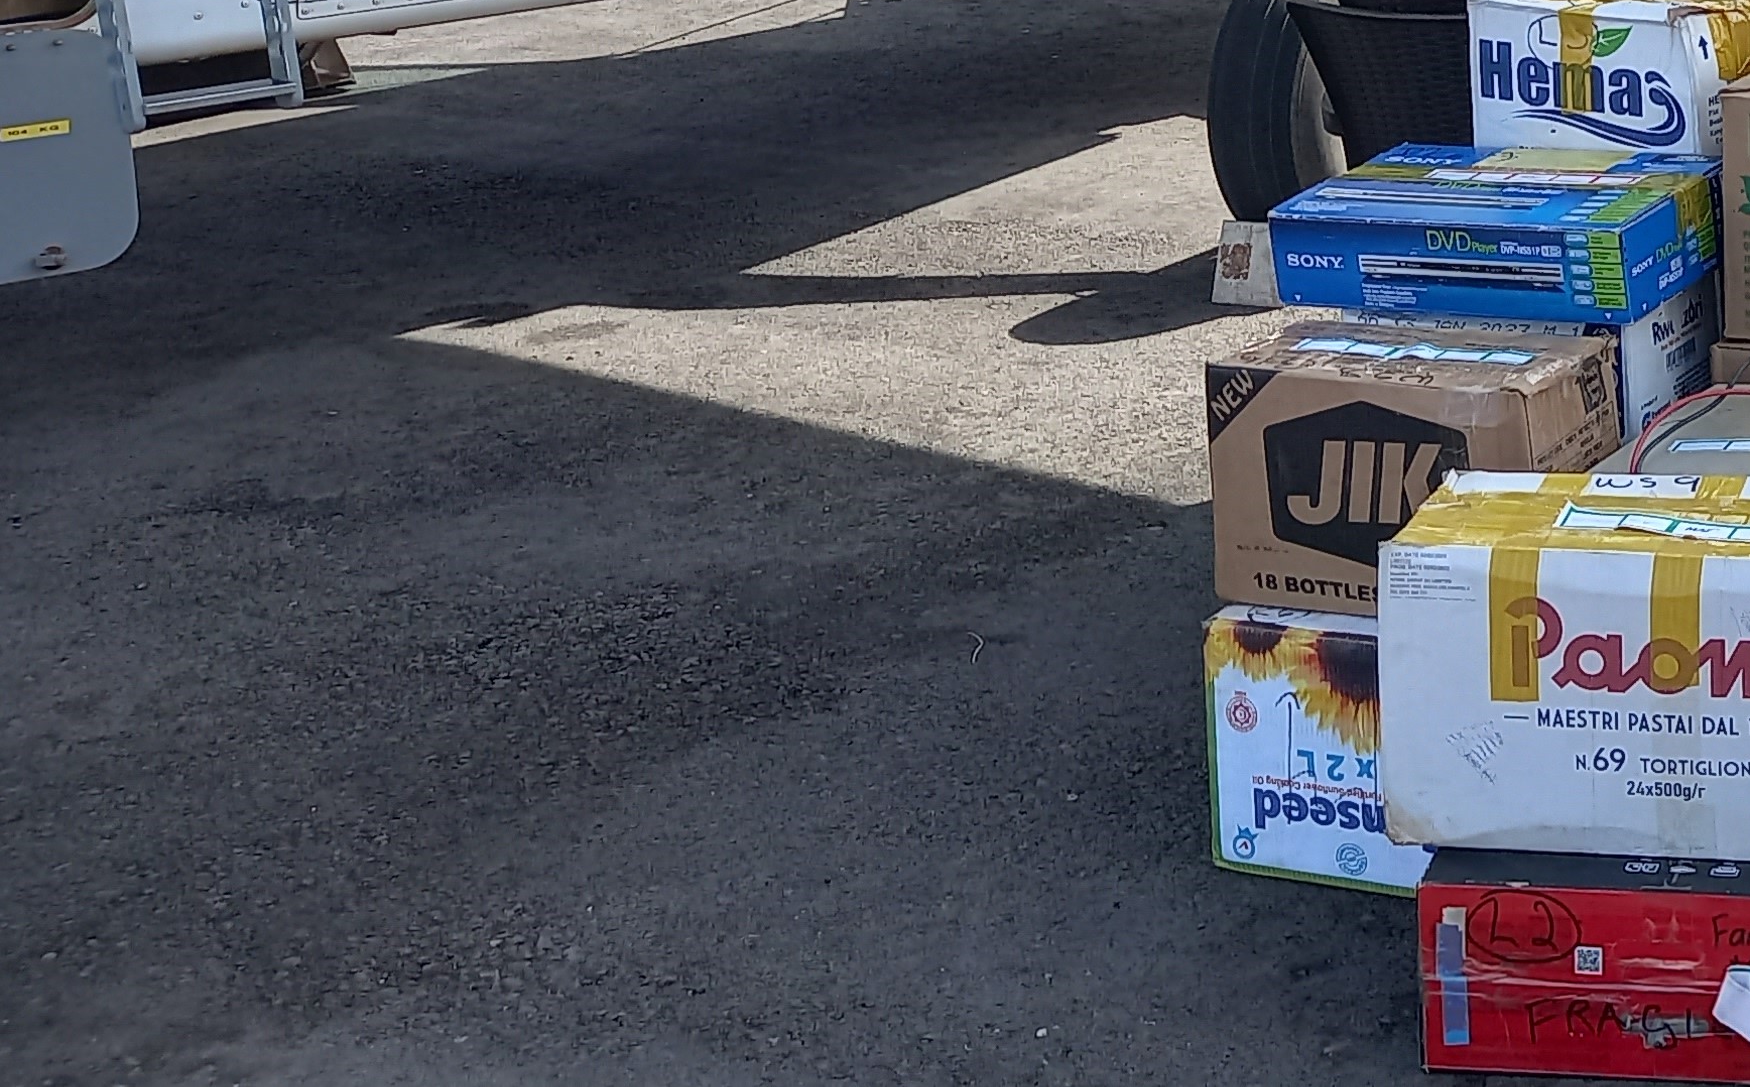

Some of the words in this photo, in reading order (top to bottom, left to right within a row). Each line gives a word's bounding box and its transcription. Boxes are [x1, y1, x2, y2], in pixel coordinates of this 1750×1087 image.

[1385, 155, 1462, 165] SONY
[1425, 229, 1472, 253] DVD
[1472, 240, 1499, 254] Player
[1632, 255, 1655, 278] SONY
[1211, 369, 1255, 422] NEW
[1285, 439, 1442, 525] JIK
[1252, 572, 1278, 591] 18
[1536, 707, 1620, 732] MAESTRI
[1628, 712, 1694, 734] PASTAI
[1702, 716, 1740, 736] DAL
[1296, 749, 1316, 778] L
[1325, 753, 1345, 782] 2
